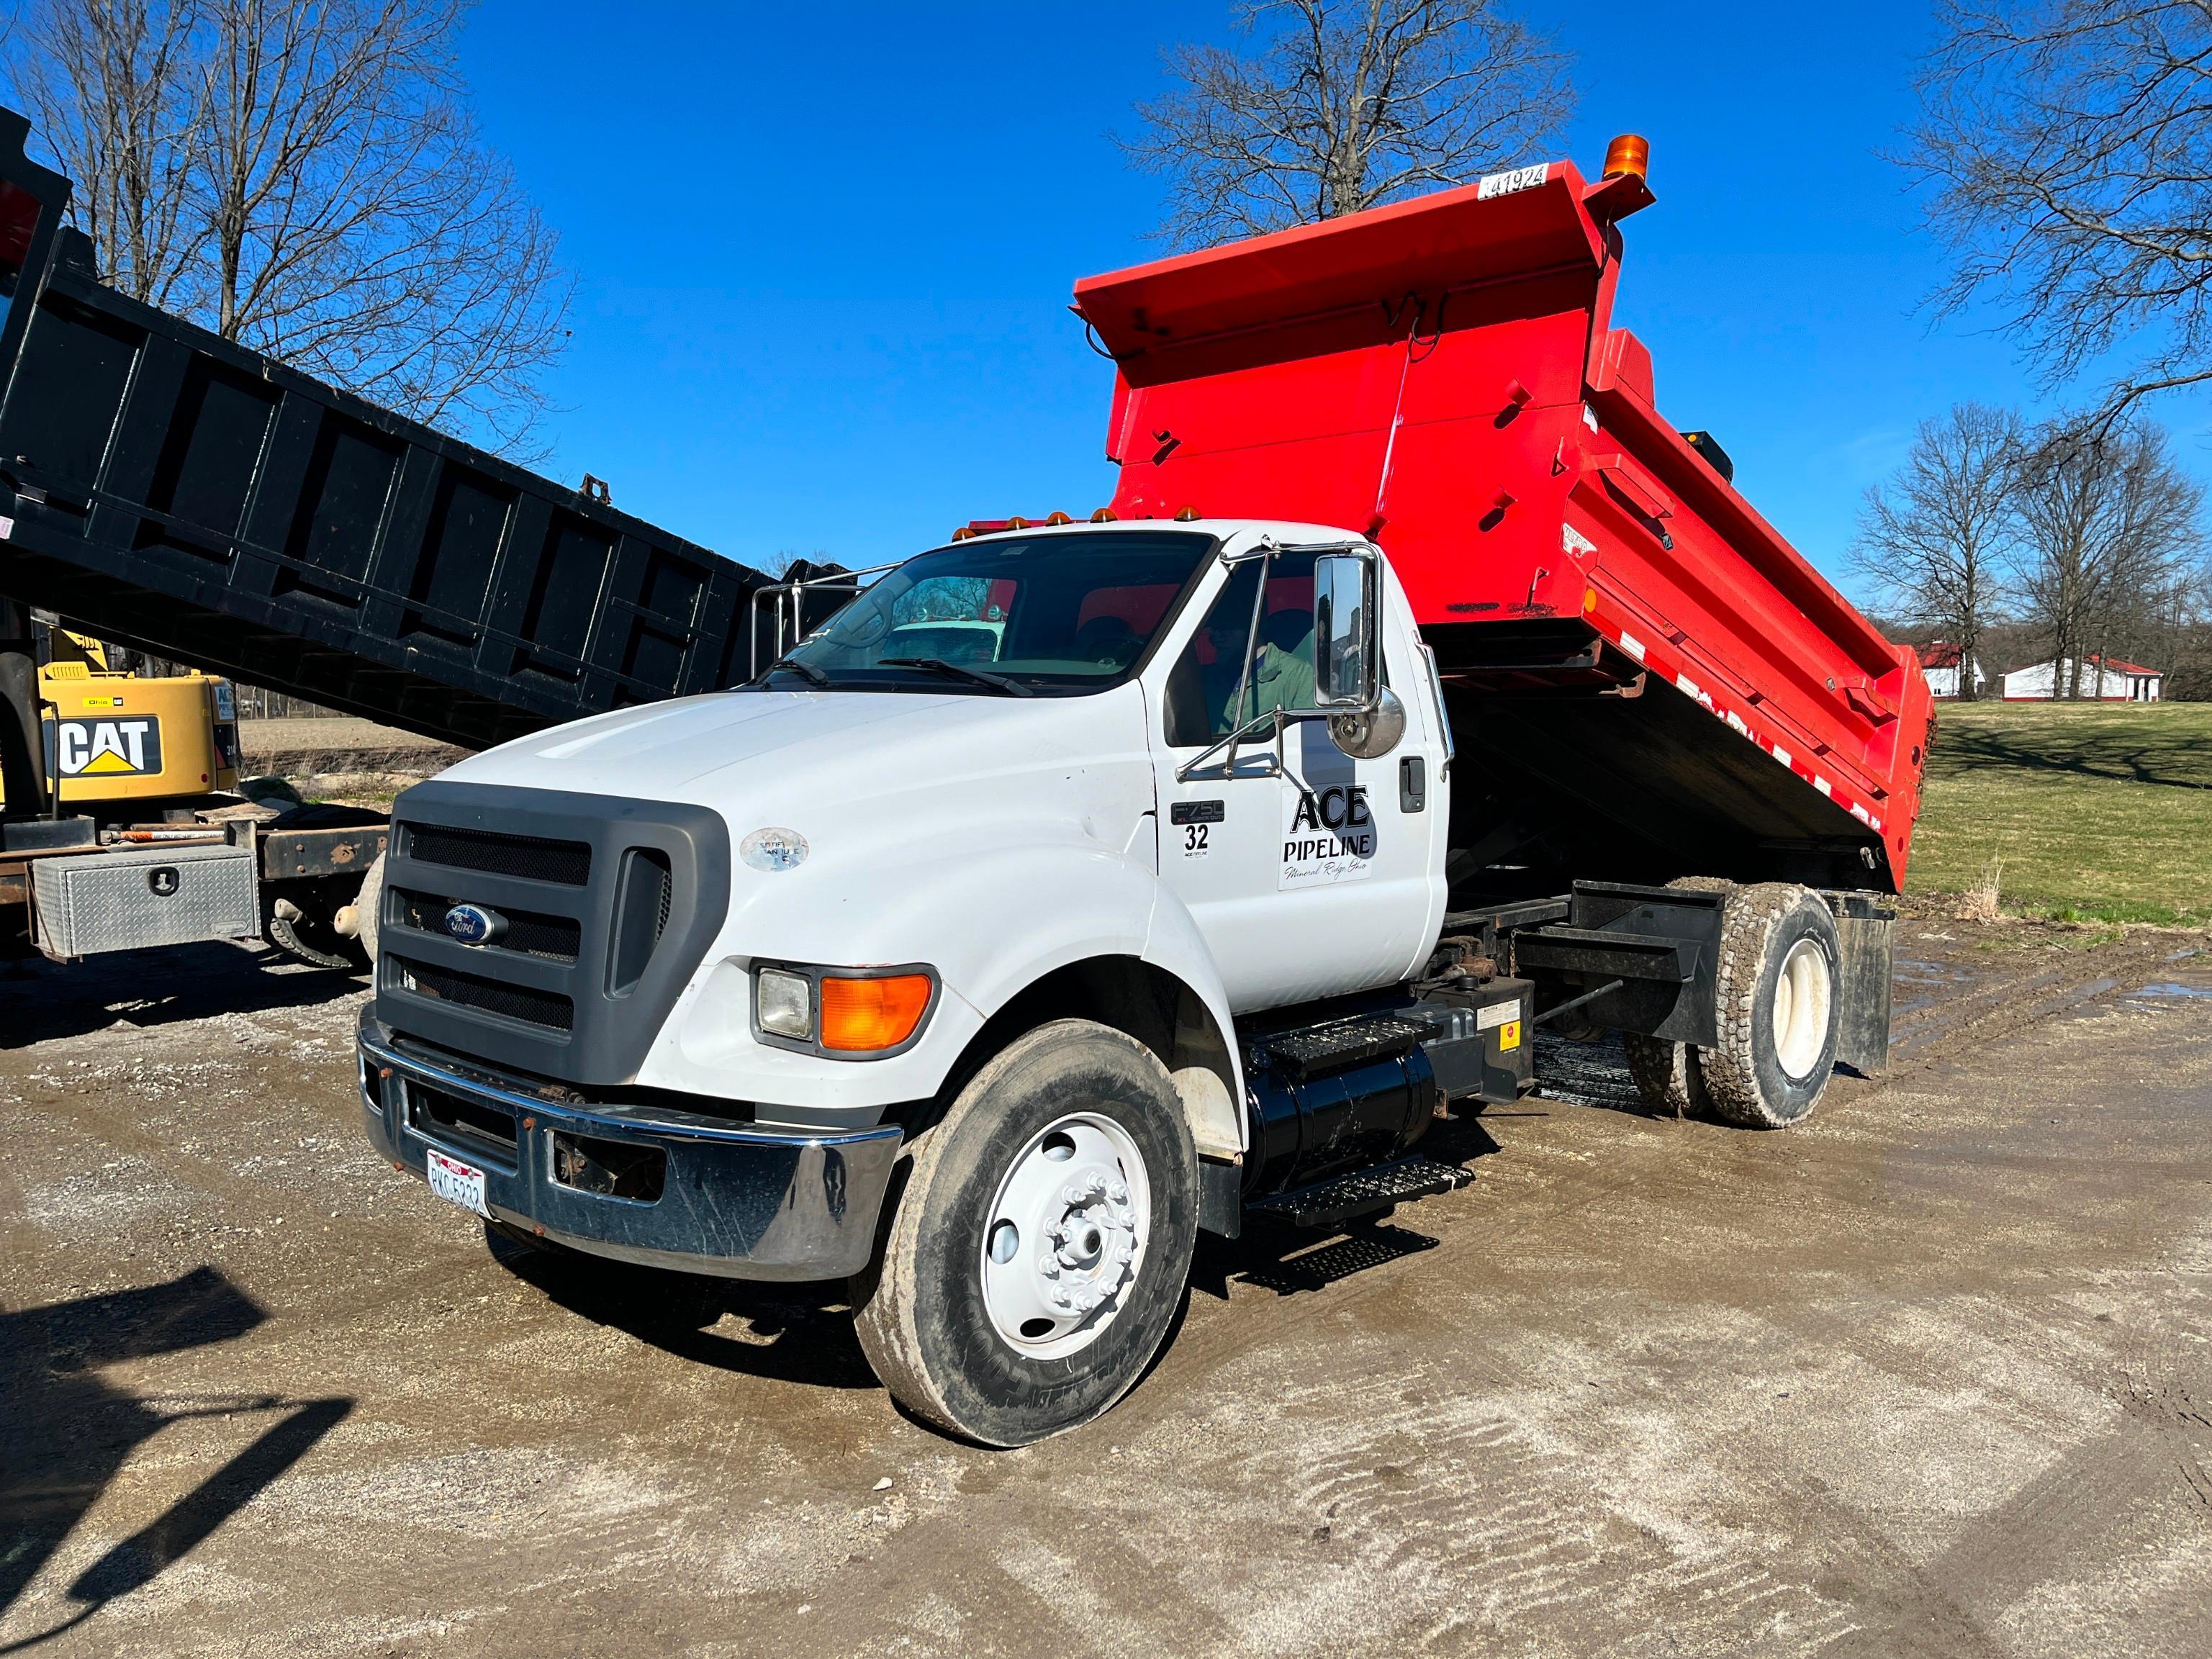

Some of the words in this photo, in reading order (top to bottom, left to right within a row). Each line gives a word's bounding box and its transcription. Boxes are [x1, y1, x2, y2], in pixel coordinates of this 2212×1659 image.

[59, 721, 148, 774] CAT
[1290, 785, 1370, 833] ACE
[1185, 824, 1208, 850] 32
[1283, 834, 1371, 862] PIPELINE
[451, 921, 476, 934] Ford
[447, 1162, 461, 1175] OHIO
